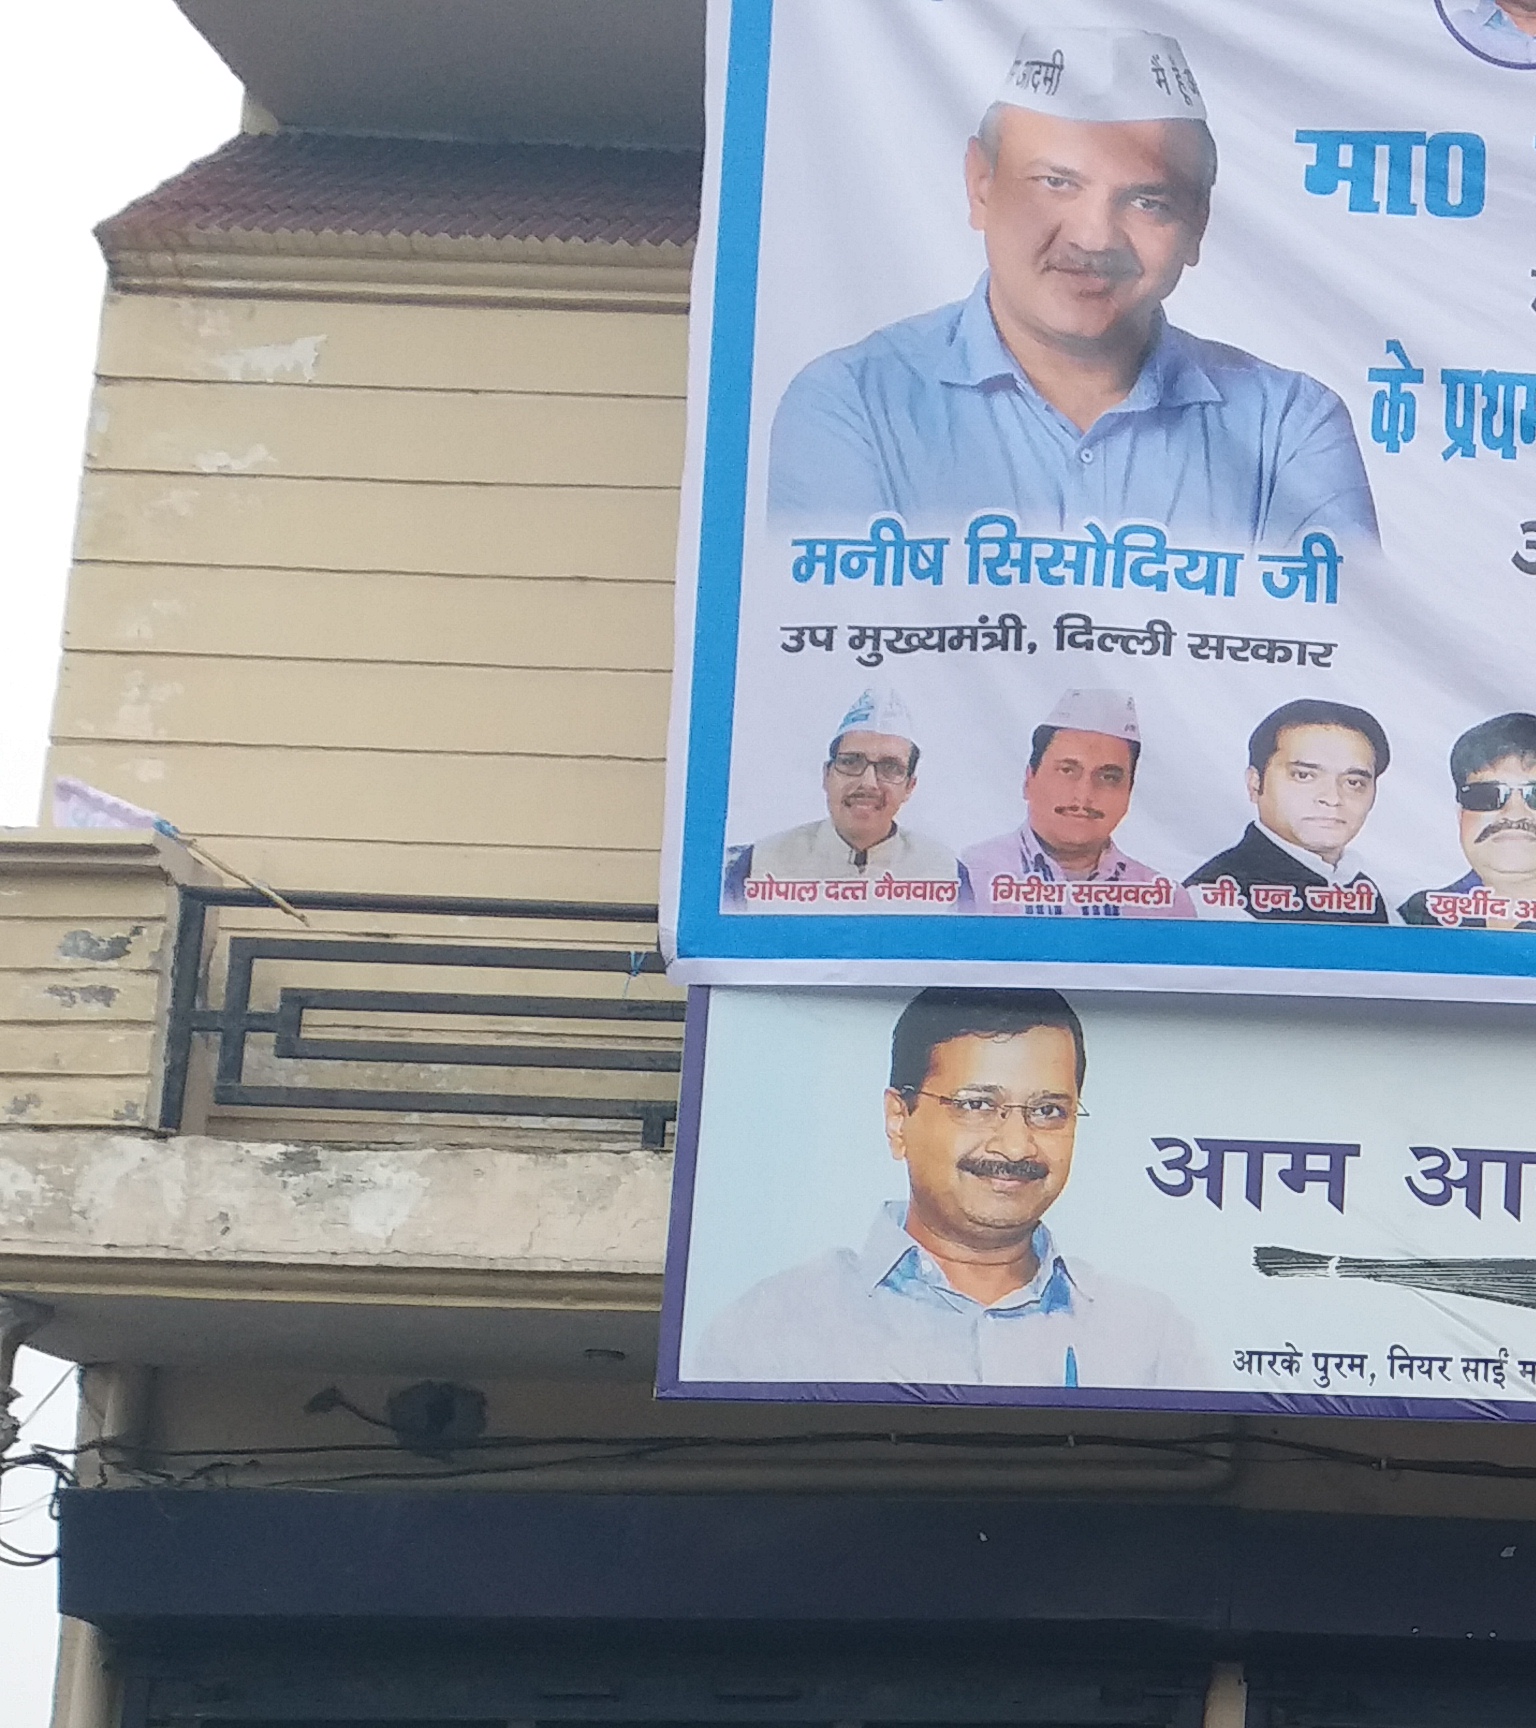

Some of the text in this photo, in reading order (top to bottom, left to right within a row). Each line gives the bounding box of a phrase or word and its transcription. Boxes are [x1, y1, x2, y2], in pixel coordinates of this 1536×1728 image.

[1368, 339, 1423, 453] के
[791, 515, 1343, 604] मनीष सिसोदिया जी
[780, 613, 1338, 668] उप मुख्यमंत्री, दिल्ली सरकार
[746, 872, 957, 902] गोपाल दत्त नैनवाल
[992, 874, 1170, 905] गिरीश सत्यवली
[1308, 881, 1374, 912] जोशी
[1428, 887, 1510, 925] खुर्शीद
[1145, 1137, 1360, 1213] आम
[1234, 1342, 1302, 1377] आरके
[1312, 1352, 1376, 1391] पुरम,
[1387, 1345, 1453, 1382] नियर
